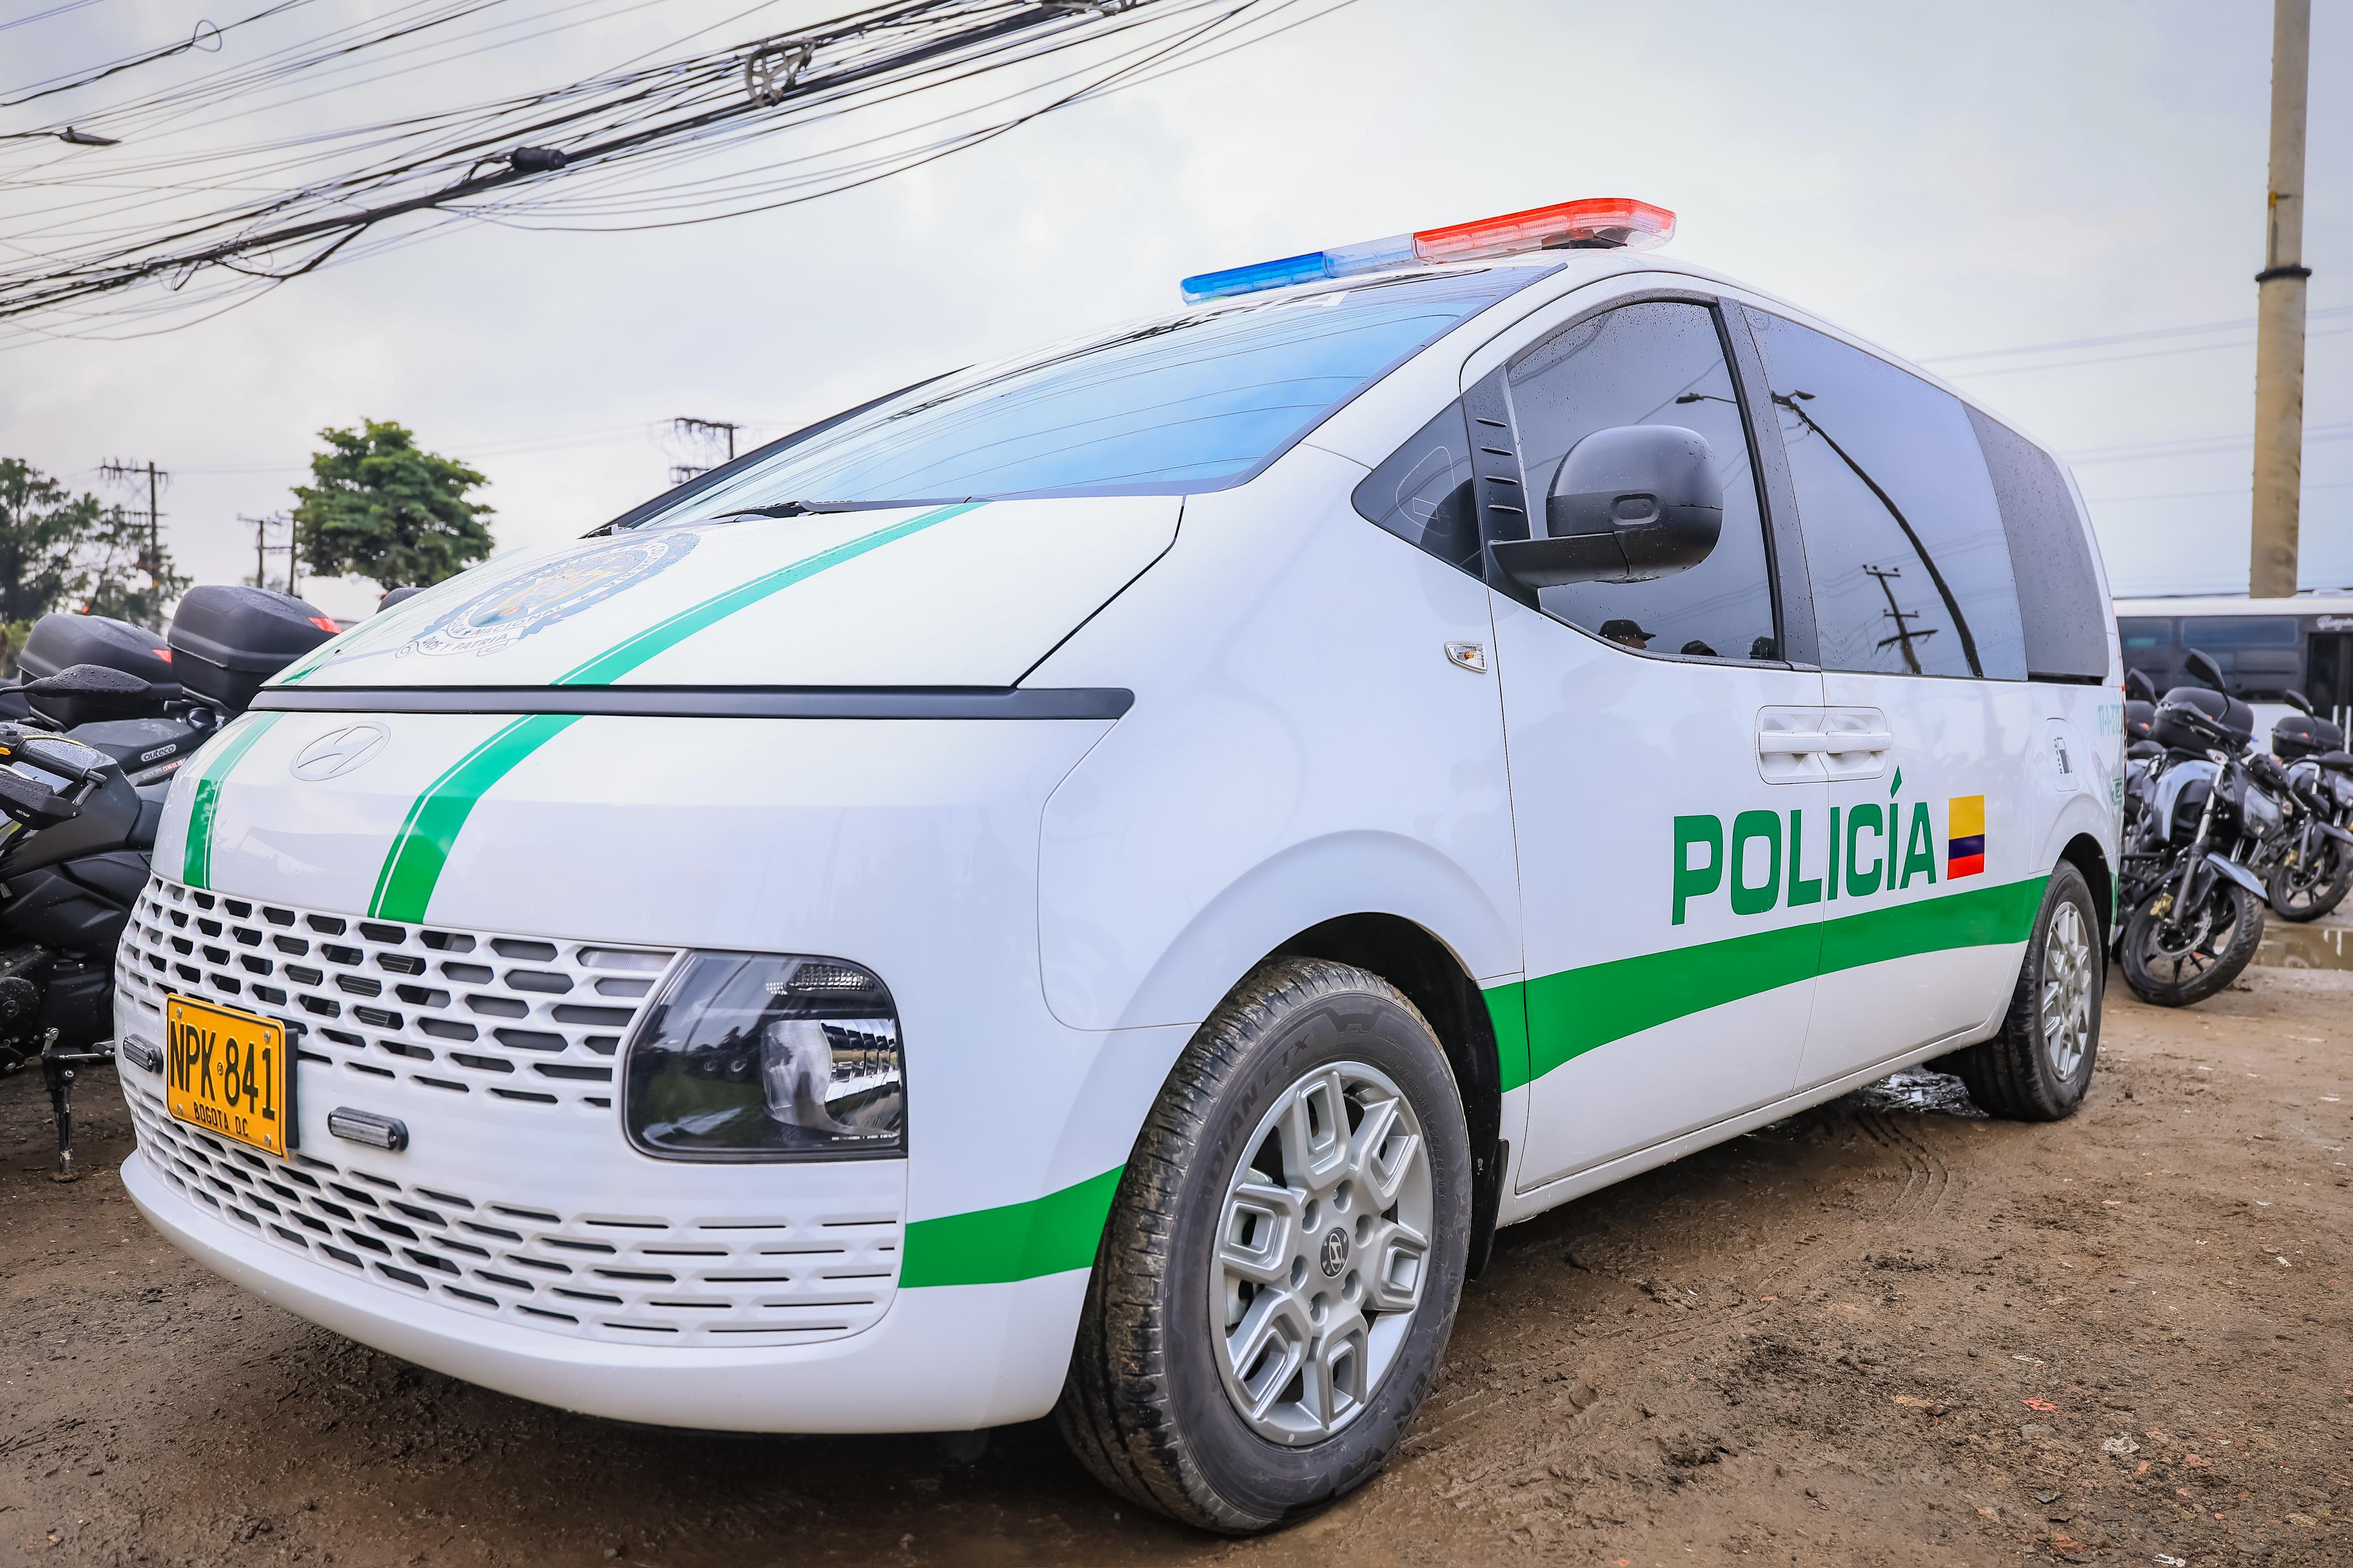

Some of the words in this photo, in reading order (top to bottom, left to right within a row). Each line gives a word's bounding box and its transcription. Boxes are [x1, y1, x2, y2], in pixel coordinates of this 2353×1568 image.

[451, 633, 508, 651] PATRIA
[144, 746, 174, 761] auteco
[1671, 765, 1937, 926] POLICÍA
[170, 1020, 217, 1101] NPK
[224, 1037, 275, 1121] 841
[193, 1101, 229, 1131] BOGOTA
